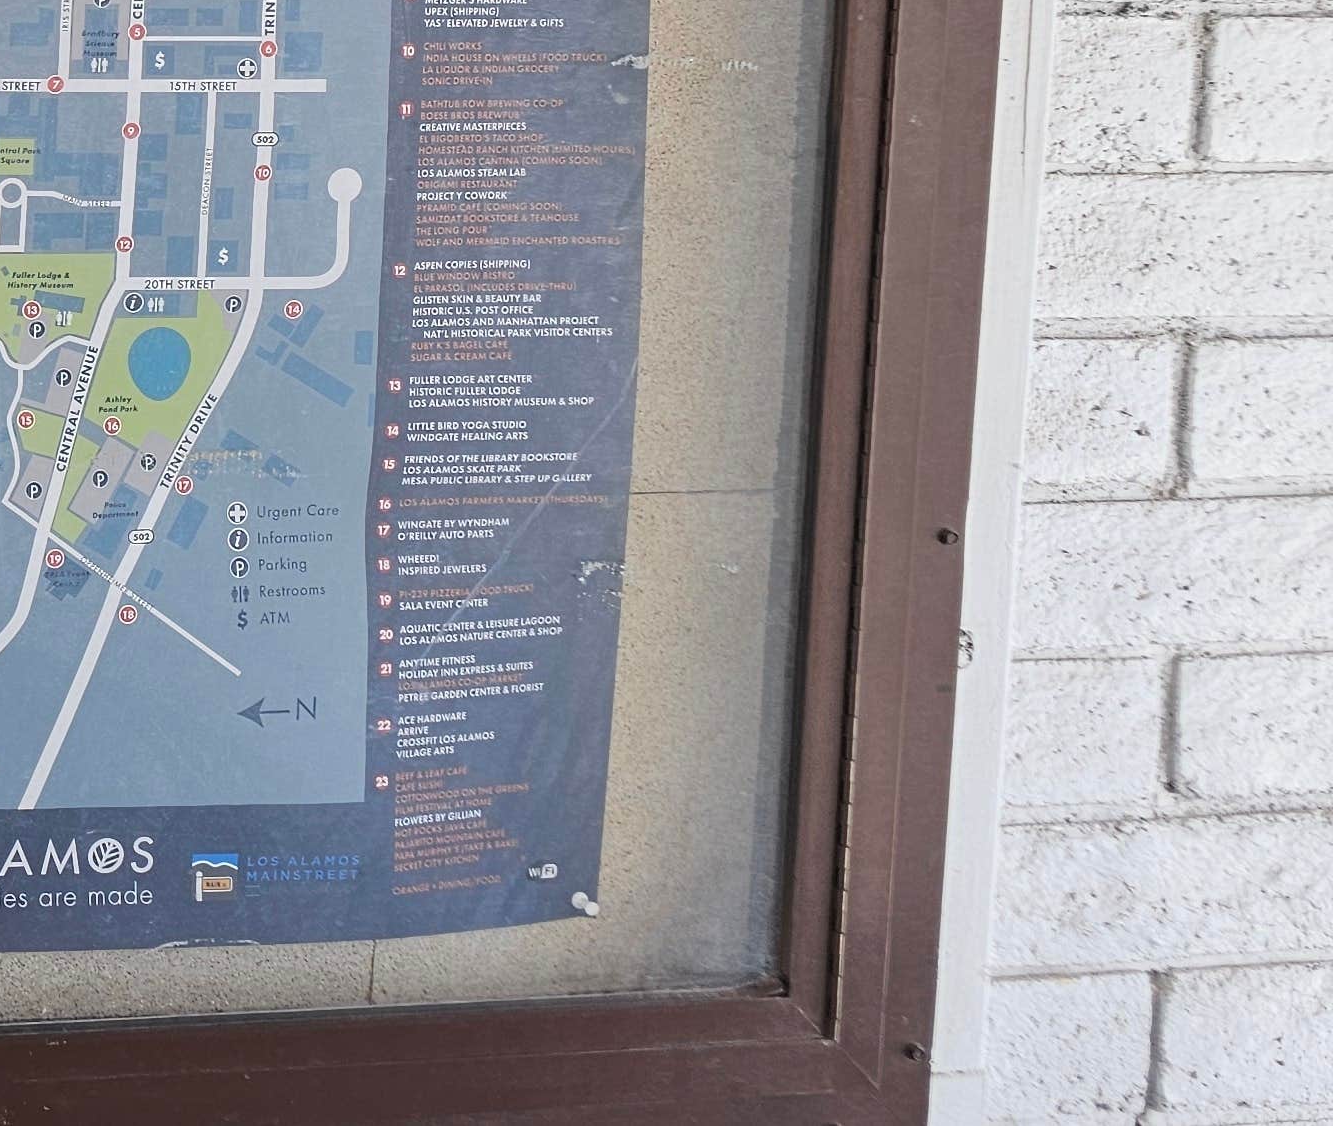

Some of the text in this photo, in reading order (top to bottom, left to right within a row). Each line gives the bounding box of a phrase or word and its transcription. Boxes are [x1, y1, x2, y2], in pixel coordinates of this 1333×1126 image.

[420, 122, 526, 132] CREATIVE MASTERPIECES
[258, 531, 332, 545] Information
[259, 557, 306, 573] Parking
[260, 586, 325, 598] Restrooms
[260, 611, 290, 624] ATM
[39, 892, 76, 907] are
[88, 887, 154, 905] made
